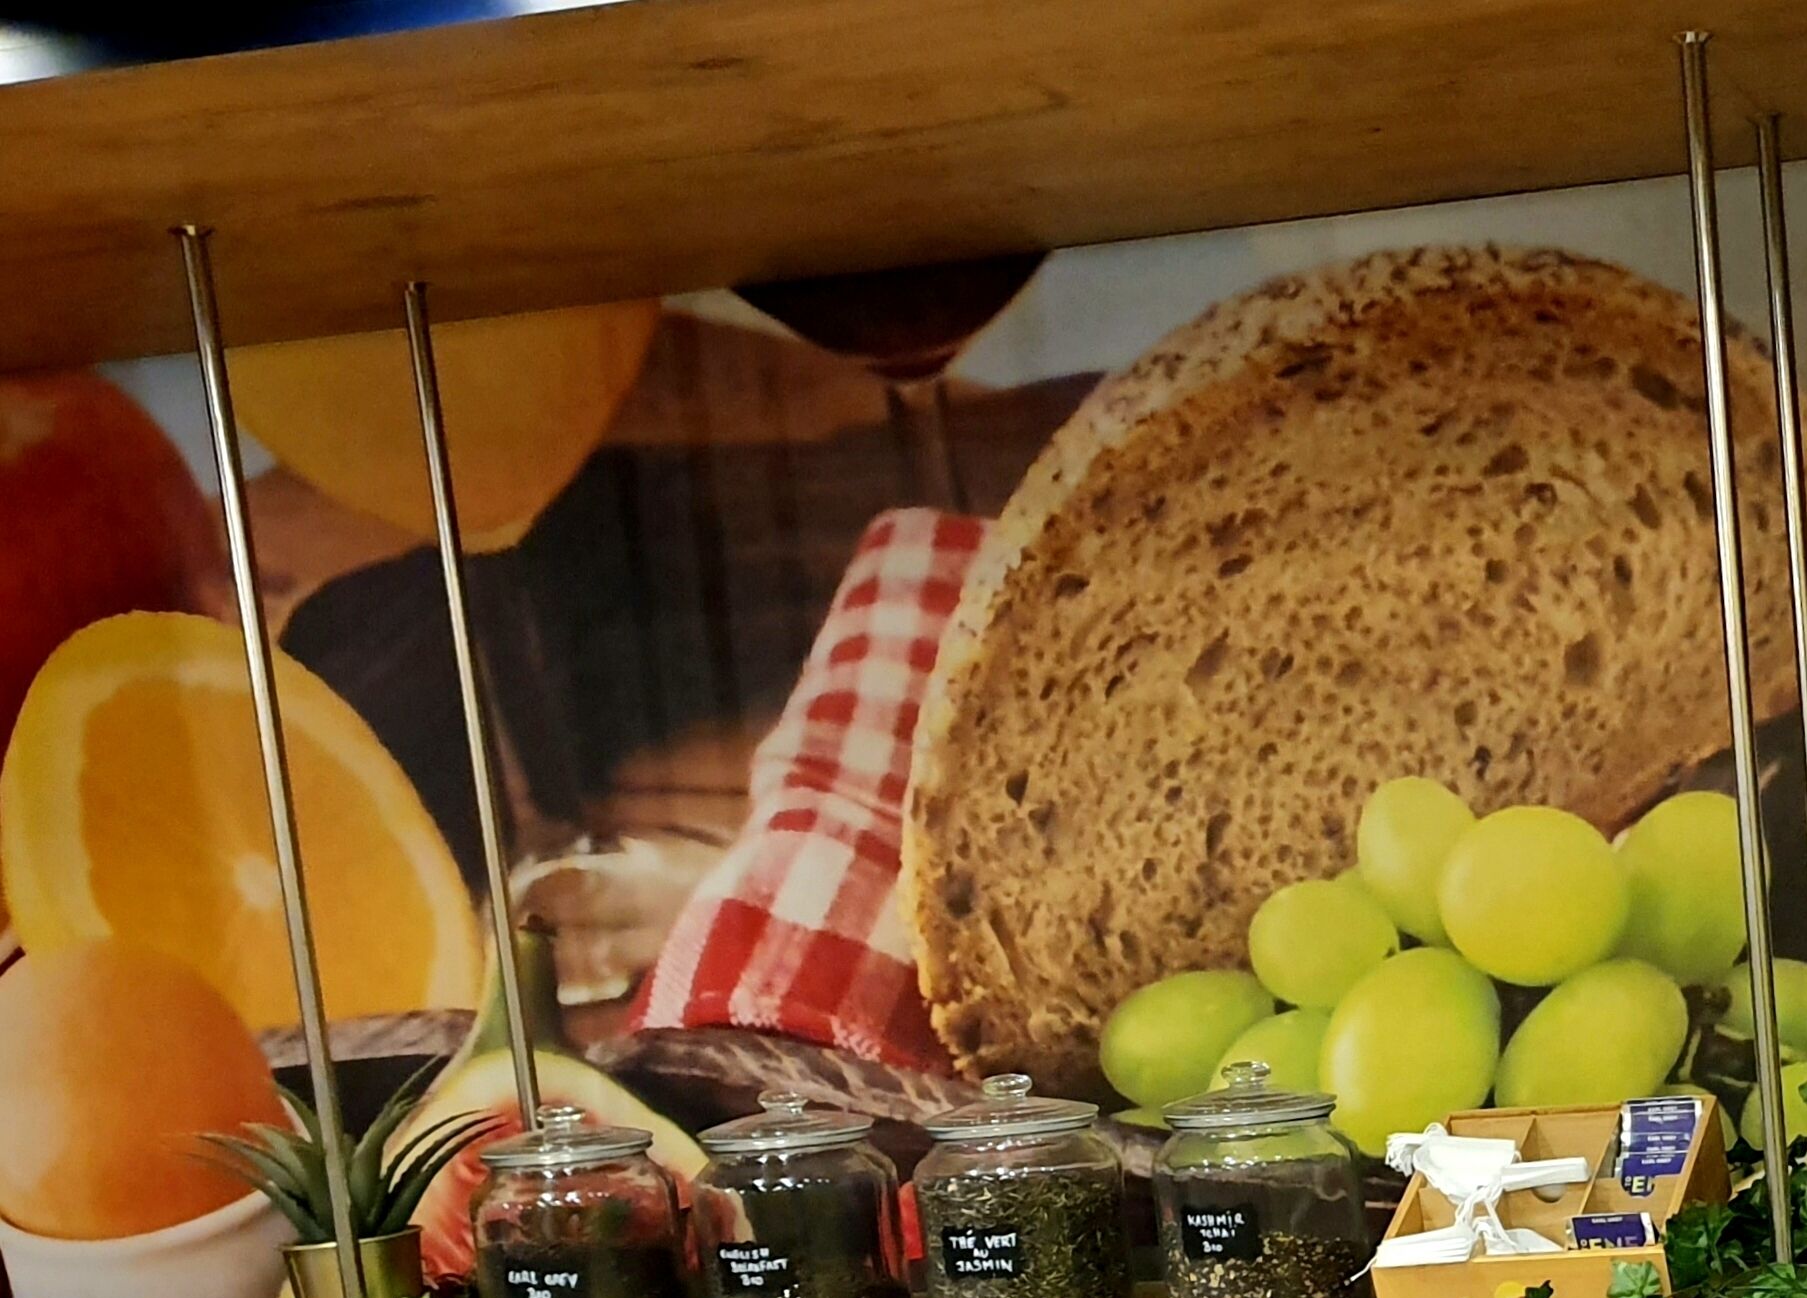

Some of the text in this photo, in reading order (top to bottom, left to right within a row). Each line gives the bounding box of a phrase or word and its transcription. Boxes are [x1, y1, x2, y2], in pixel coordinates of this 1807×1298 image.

[948, 1229, 1017, 1249] THÉ VERT
[972, 1247, 990, 1259] AU
[955, 1259, 1014, 1273] JASMIN
